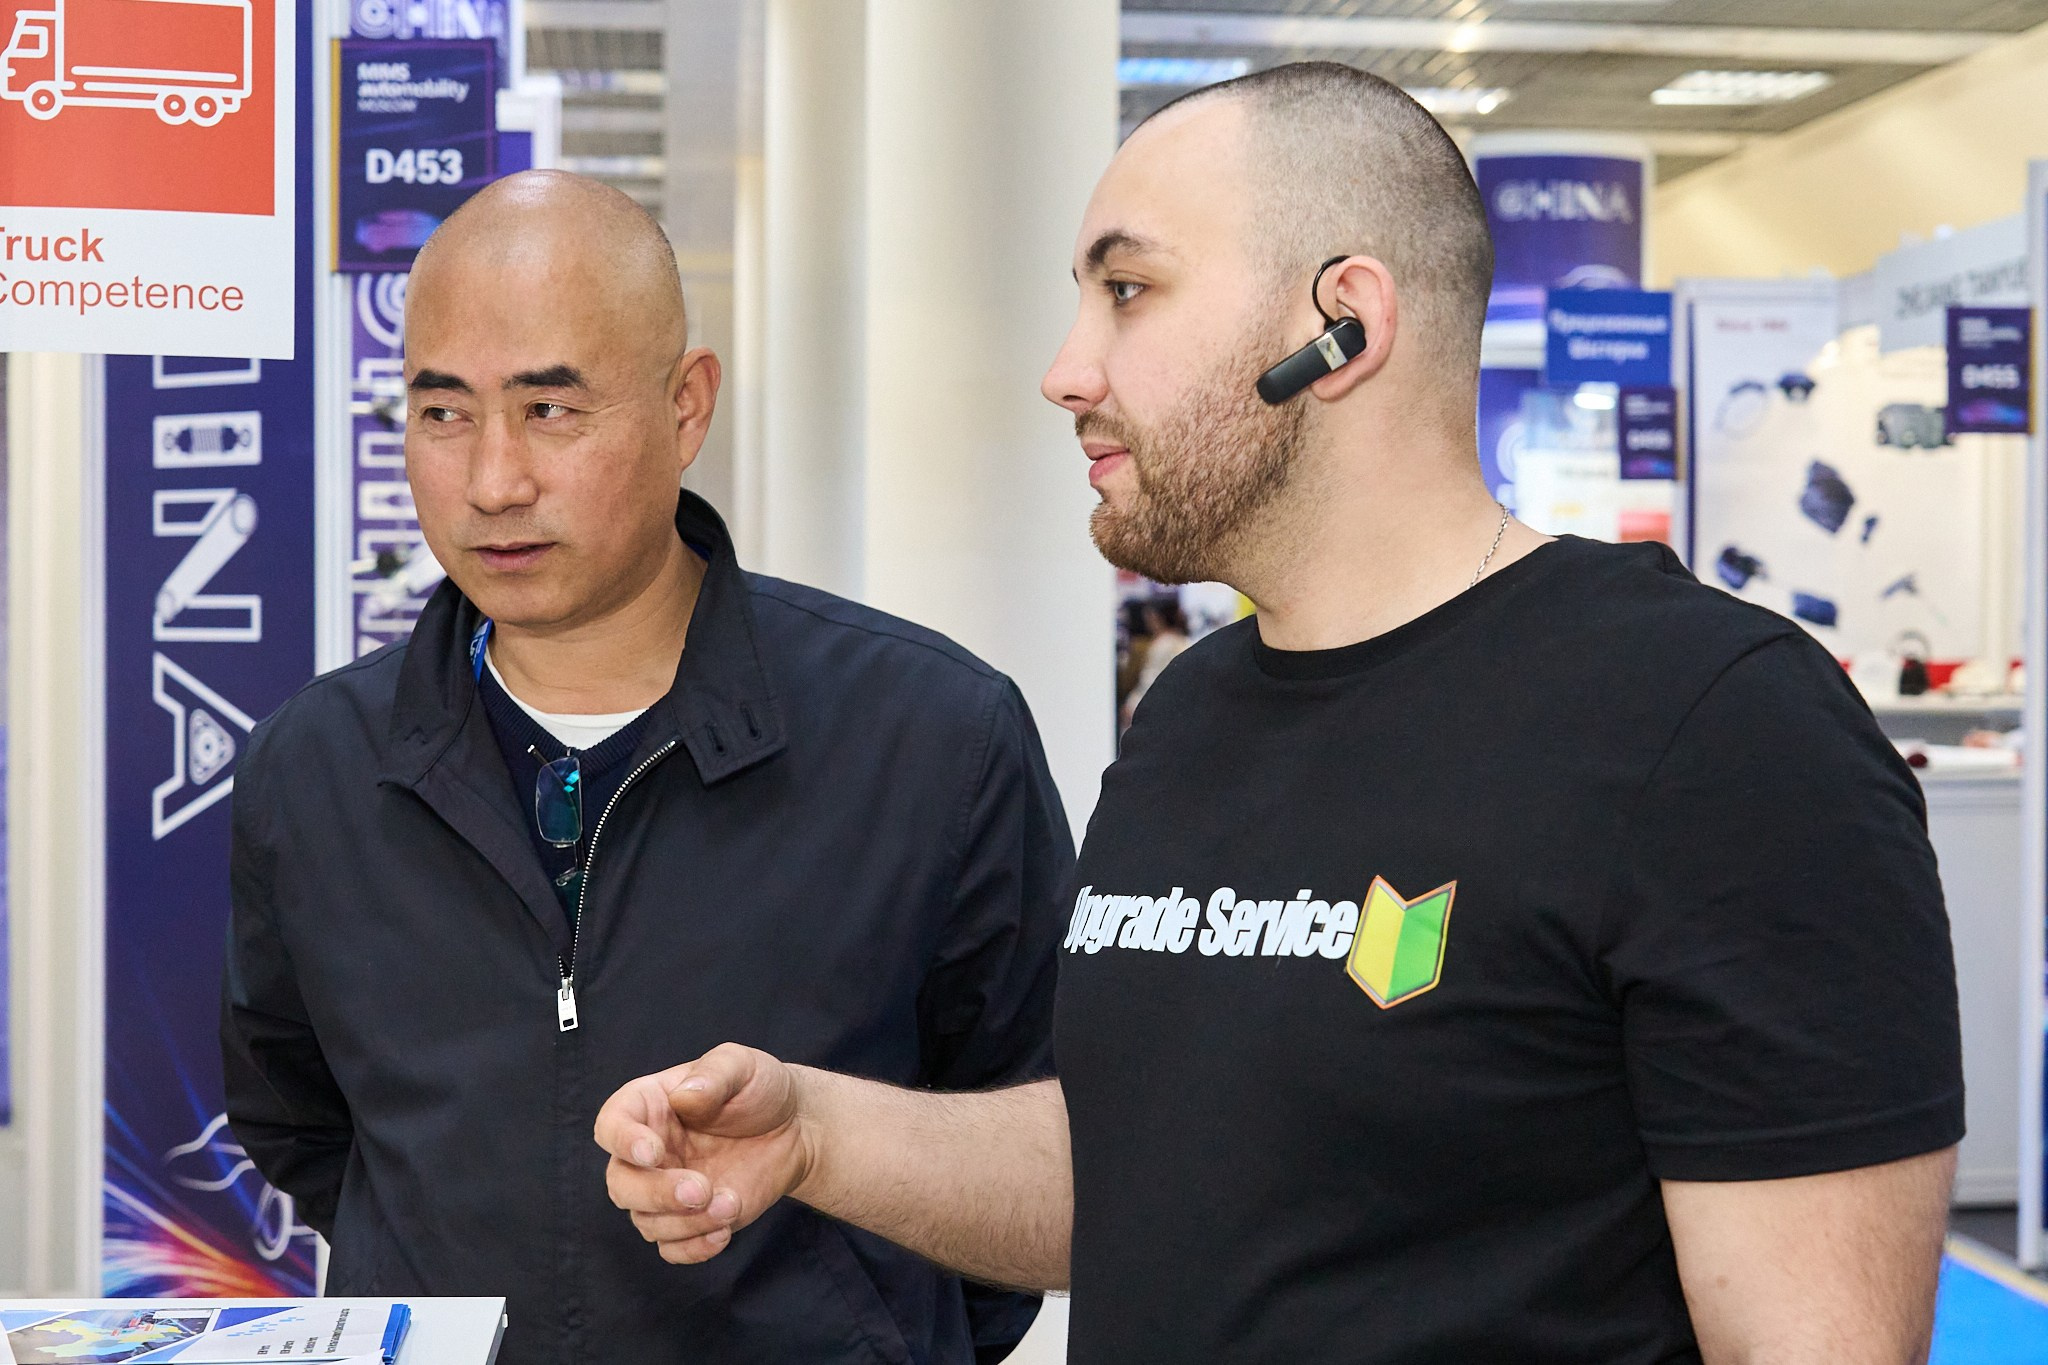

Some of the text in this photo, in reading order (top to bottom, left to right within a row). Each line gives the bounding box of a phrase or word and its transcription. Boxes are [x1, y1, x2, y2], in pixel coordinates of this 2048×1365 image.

[358, 78, 469, 103] automobility
[365, 148, 463, 185] D453
[0, 227, 104, 262] ruck
[1063, 885, 1360, 960] Upgrade Service
